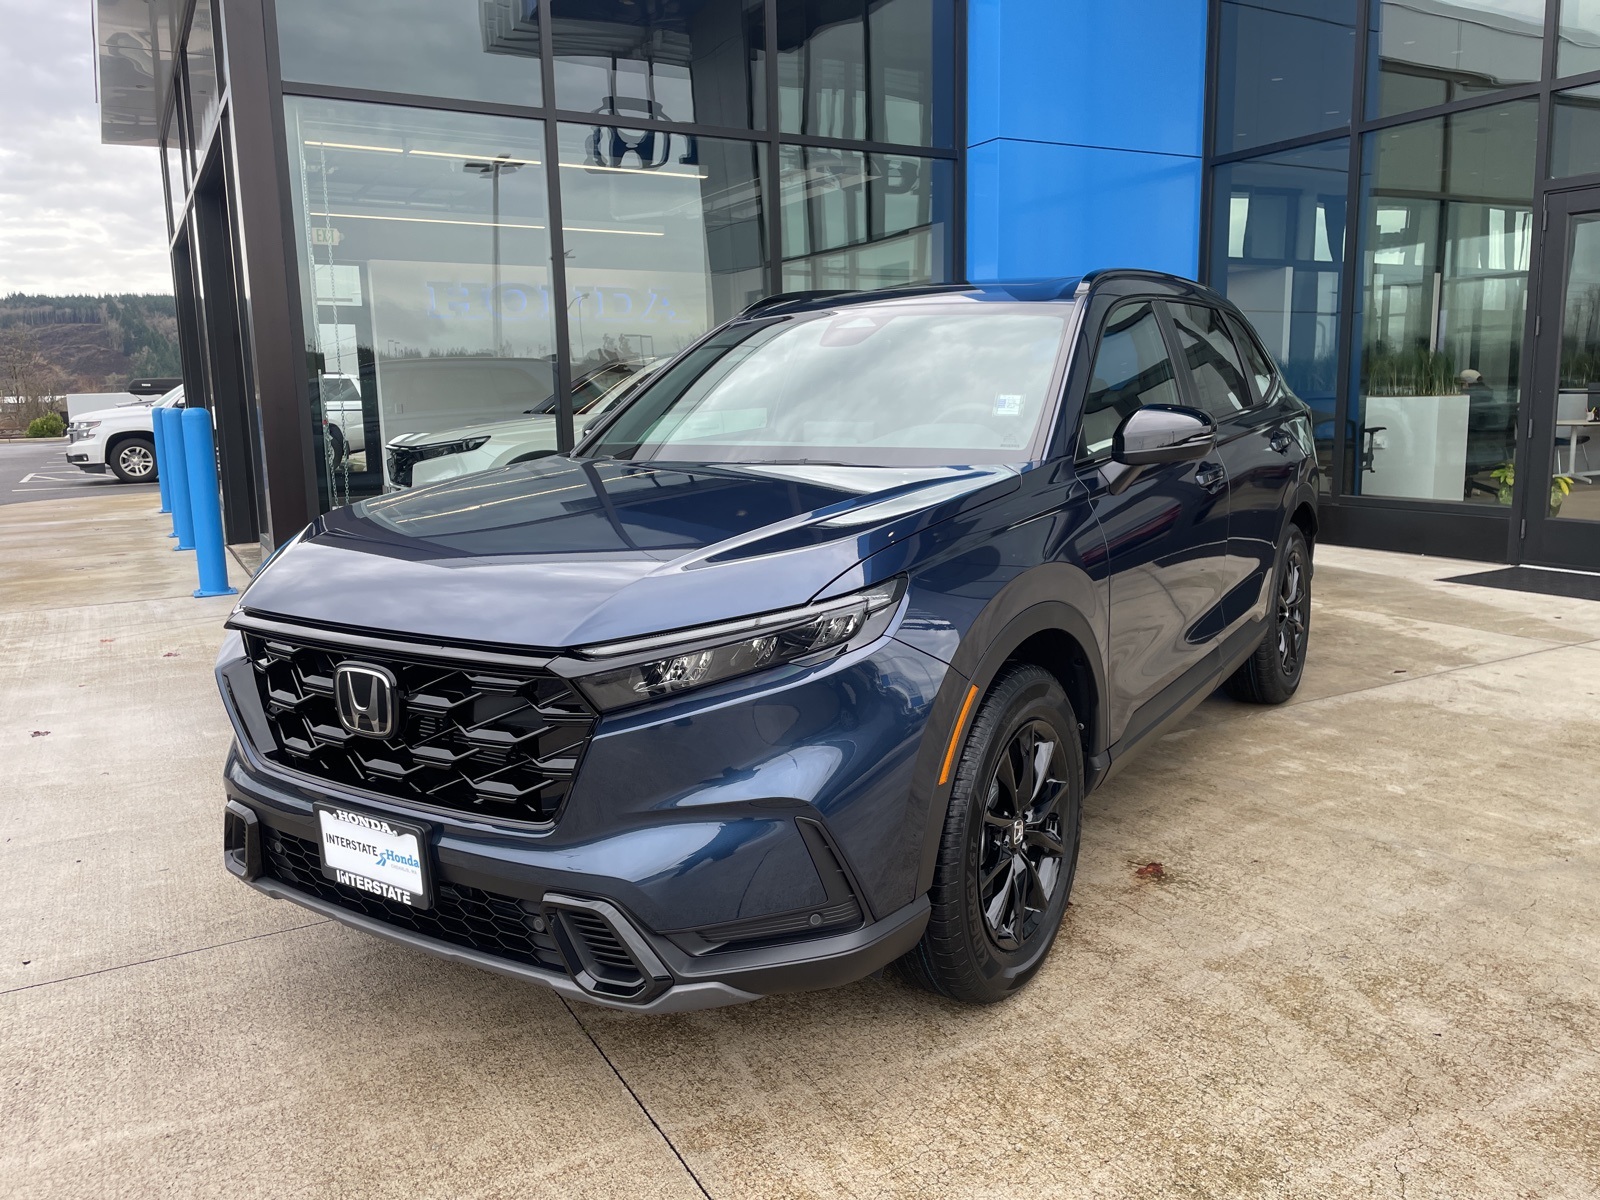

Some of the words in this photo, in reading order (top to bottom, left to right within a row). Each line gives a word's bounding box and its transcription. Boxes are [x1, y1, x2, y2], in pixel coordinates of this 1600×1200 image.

[336, 809, 394, 836] HONDA
[325, 832, 379, 857] INTERSTATE
[385, 848, 420, 868] Honda
[336, 869, 412, 905] INTERSTATE
